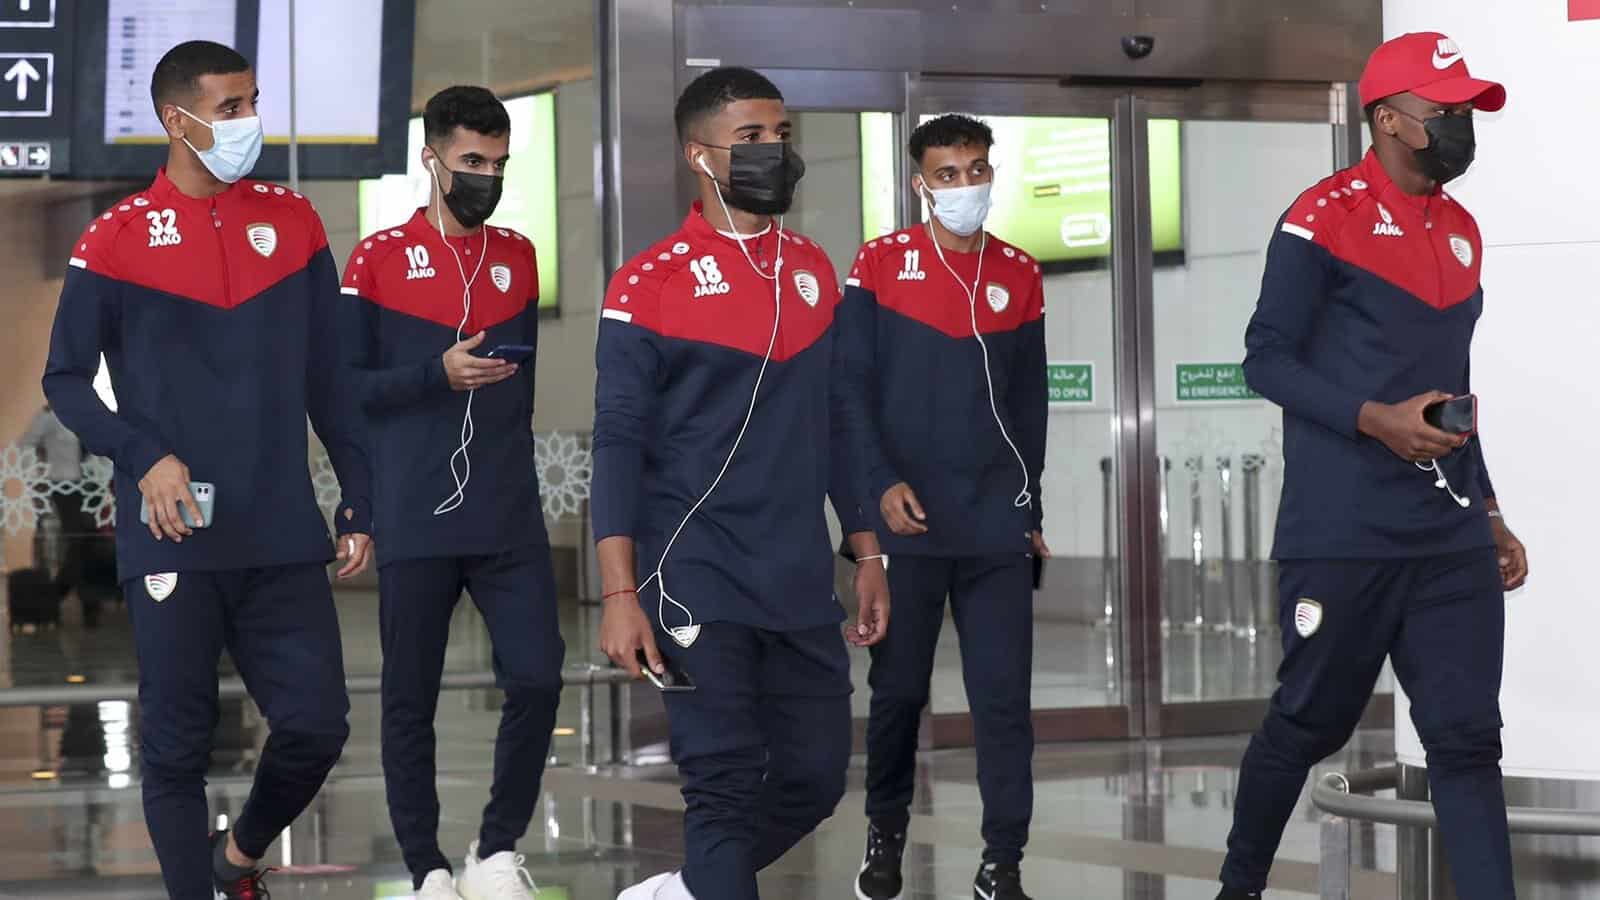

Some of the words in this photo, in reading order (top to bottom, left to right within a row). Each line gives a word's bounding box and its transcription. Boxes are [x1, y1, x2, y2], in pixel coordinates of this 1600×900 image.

[146, 208, 178, 237] 32
[148, 232, 182, 248] JAKO
[405, 244, 430, 269] 10
[904, 249, 920, 272] 11
[406, 266, 436, 280] JAKO
[690, 255, 723, 286] 18
[897, 269, 926, 281] JAKO
[694, 281, 731, 298] JAKO
[1062, 387, 1089, 400] OPEN
[1191, 384, 1248, 398] EMERGENCY
